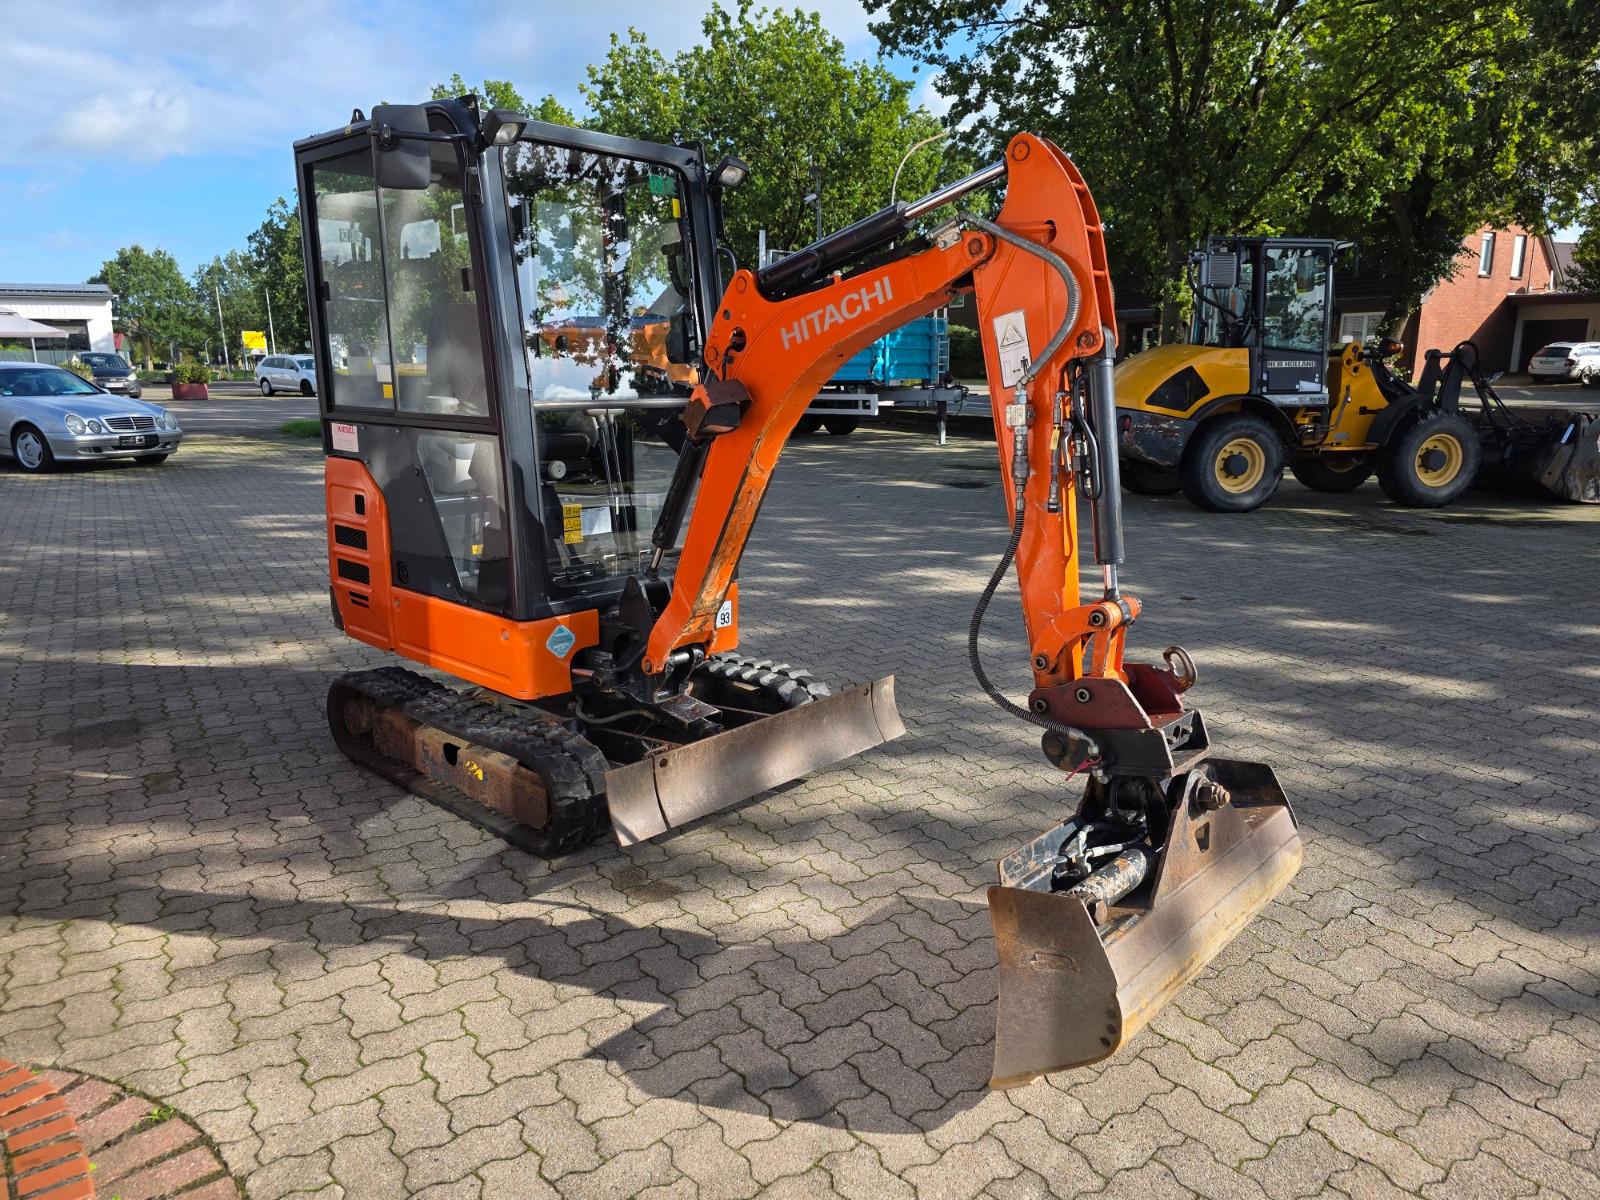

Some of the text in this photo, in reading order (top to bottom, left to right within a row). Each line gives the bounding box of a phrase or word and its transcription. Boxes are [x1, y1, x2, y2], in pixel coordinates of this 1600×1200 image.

[780, 276, 893, 350] HITACHI
[1267, 360, 1283, 368] NEW
[720, 612, 730, 625] 93
